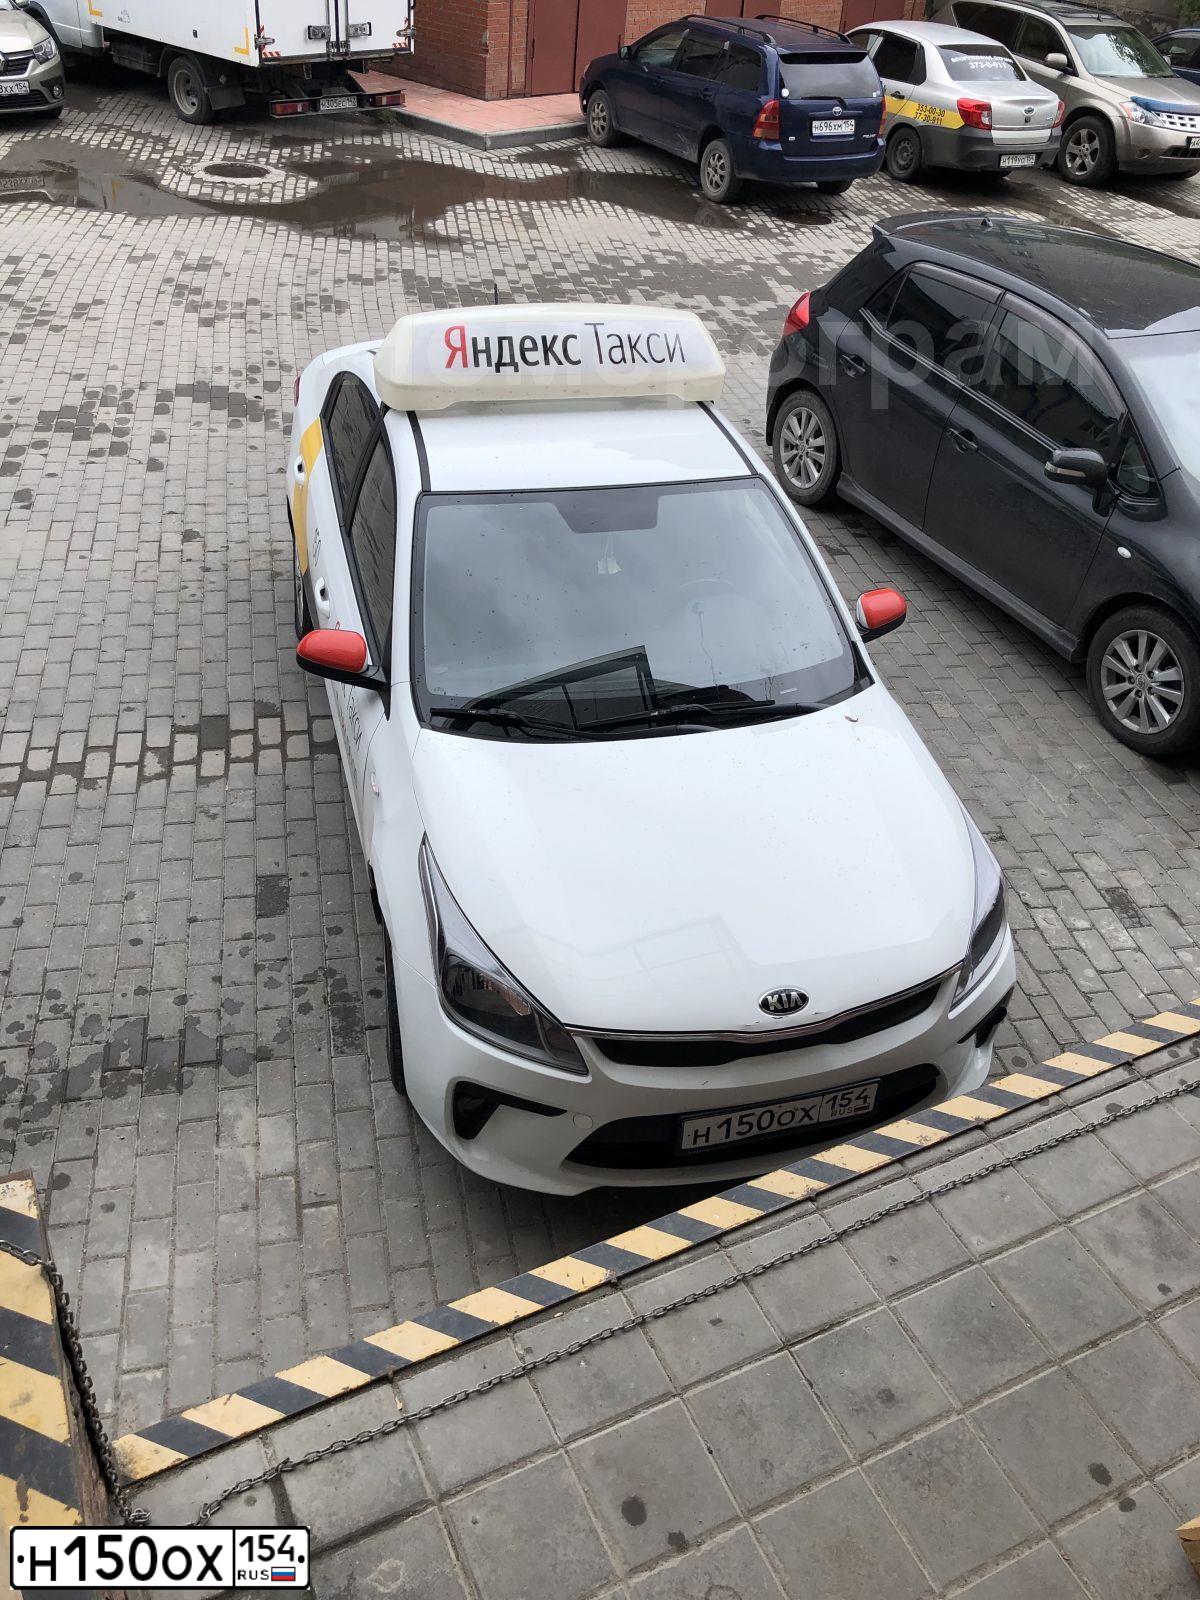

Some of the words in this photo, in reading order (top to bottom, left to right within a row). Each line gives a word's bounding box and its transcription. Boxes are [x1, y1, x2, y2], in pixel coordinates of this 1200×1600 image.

[444, 325, 582, 373] Яндекс
[584, 322, 686, 365] Такси
[766, 991, 803, 1011] KIA
[826, 1087, 870, 1110] 154
[831, 1106, 853, 1117] RUS
